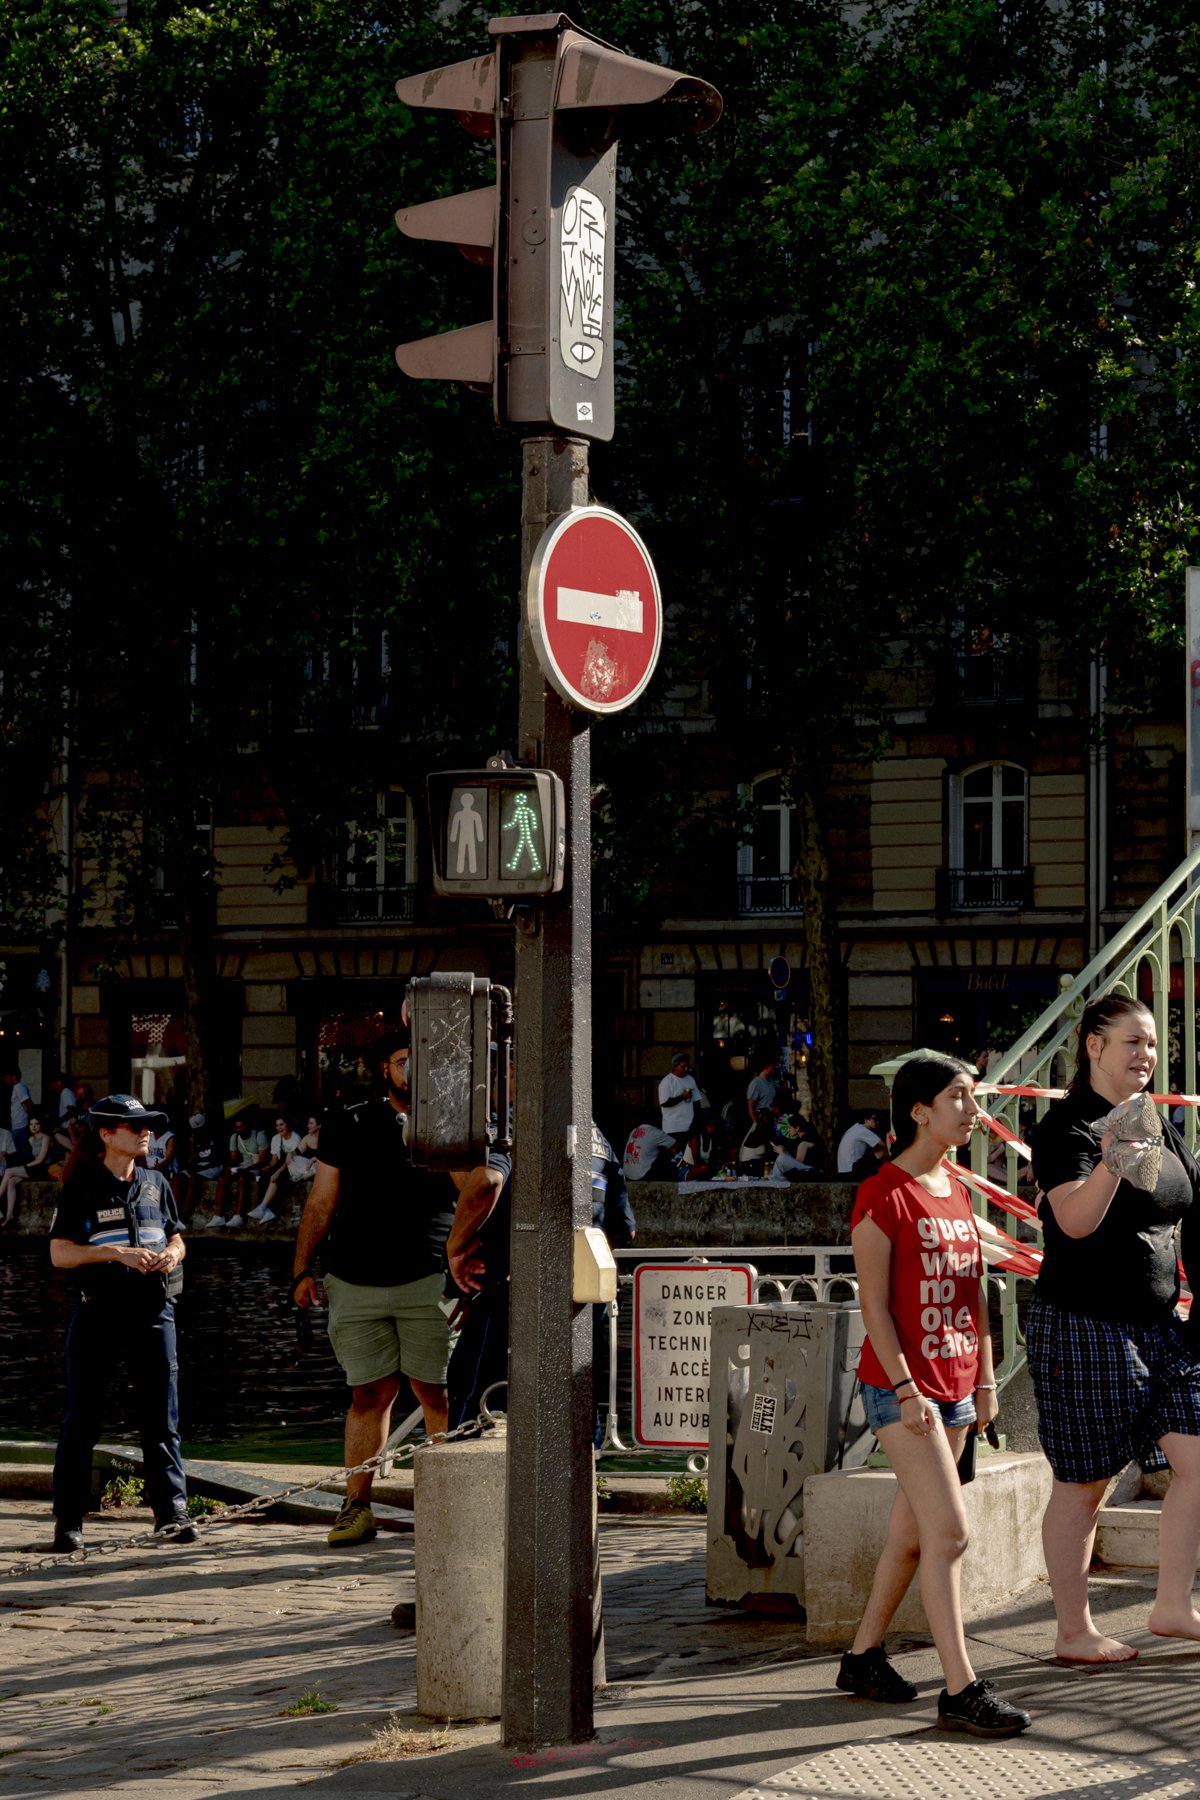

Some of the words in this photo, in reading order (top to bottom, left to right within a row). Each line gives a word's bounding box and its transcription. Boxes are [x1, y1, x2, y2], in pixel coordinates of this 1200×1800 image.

[97, 1207, 124, 1218] POLICE
[917, 1217, 978, 1249] gues
[920, 1244, 978, 1279] what
[662, 1285, 727, 1300] DANGER
[919, 1279, 956, 1304] no
[920, 1305, 971, 1332] one
[648, 1336, 711, 1351] TECHNI
[670, 1360, 709, 1377] ACCÈ
[658, 1387, 710, 1402] INTER
[755, 1396, 763, 1411] WAS
[653, 1412, 673, 1427] AU
[680, 1413, 710, 1428] PUB
[751, 1411, 761, 1431] HERE
[760, 1397, 776, 1433] STALK
